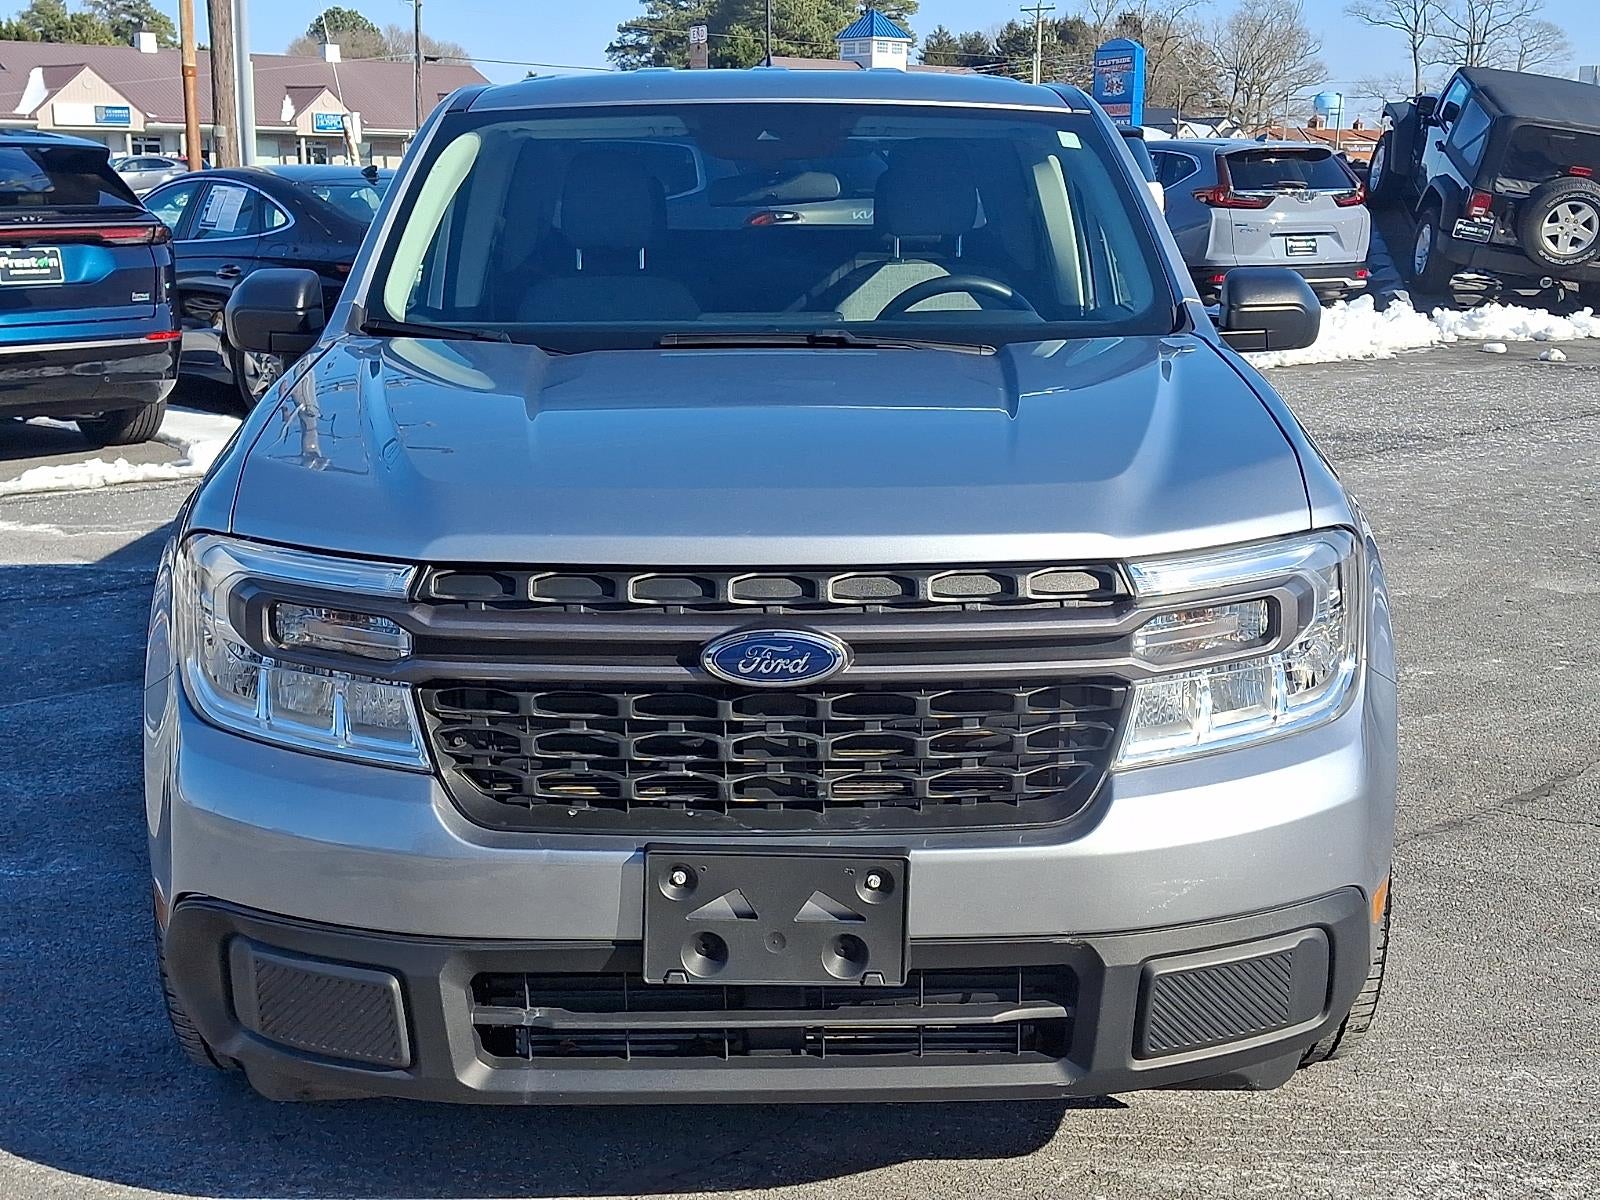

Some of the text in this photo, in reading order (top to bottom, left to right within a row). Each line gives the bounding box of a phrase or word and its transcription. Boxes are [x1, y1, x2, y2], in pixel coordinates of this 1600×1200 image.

[691, 28, 705, 41] END
[1098, 57, 1131, 66] EASTSIDE
[317, 118, 344, 127] HOSPIC
[737, 644, 810, 674] Ford
